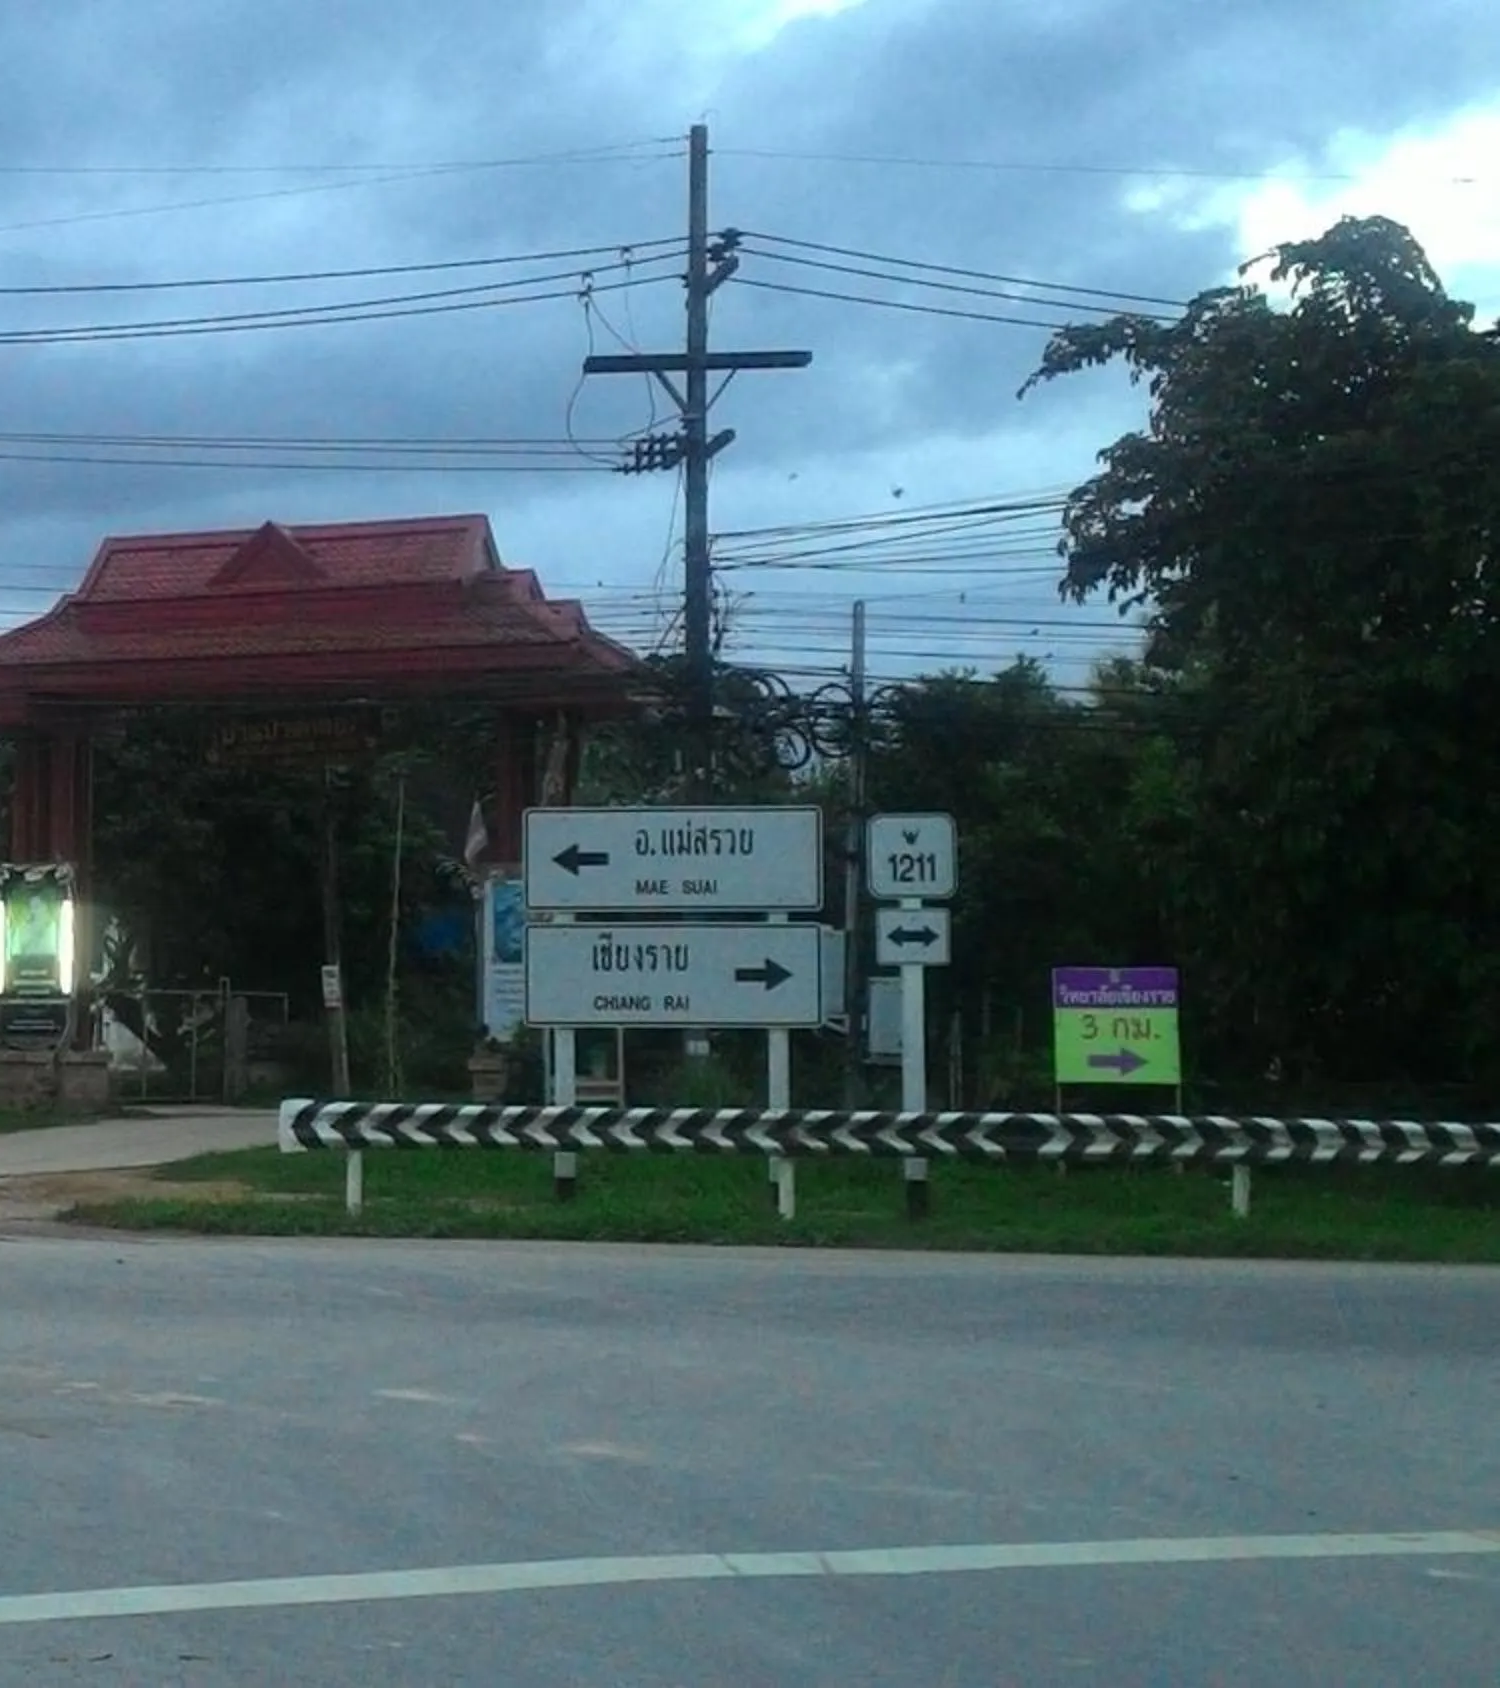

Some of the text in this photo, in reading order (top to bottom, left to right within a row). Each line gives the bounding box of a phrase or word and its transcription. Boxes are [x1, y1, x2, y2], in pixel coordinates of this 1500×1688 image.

[635, 820, 754, 856] อ.แม่สรวย
[887, 853, 937, 882] 1211
[636, 879, 718, 895] MAE SUAI
[593, 932, 689, 972] เชียงราย
[594, 995, 690, 1011] CHIANG RAI
[1081, 1014, 1162, 1041] 3 กม.
